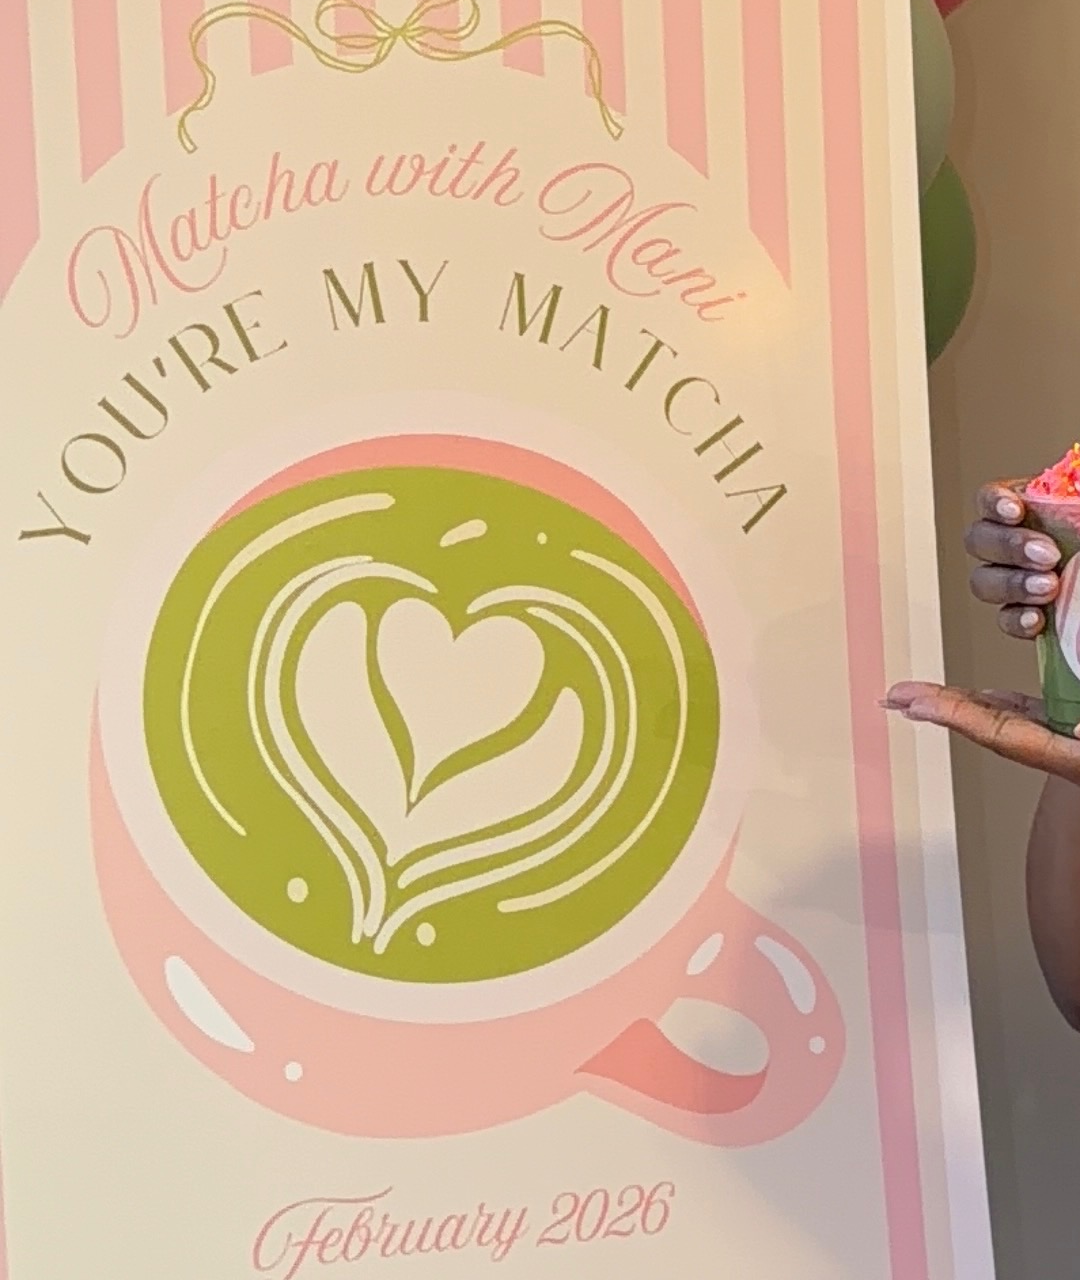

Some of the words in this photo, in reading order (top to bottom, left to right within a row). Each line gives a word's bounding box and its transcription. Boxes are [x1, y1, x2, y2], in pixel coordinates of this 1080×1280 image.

[67, 151, 350, 339] Matcha
[365, 140, 524, 206] with
[538, 162, 749, 322] Mani
[18, 289, 288, 549] YOU'RE
[322, 259, 451, 332] MY
[498, 272, 789, 534] MATCHA
[536, 1181, 676, 1247] 2026
